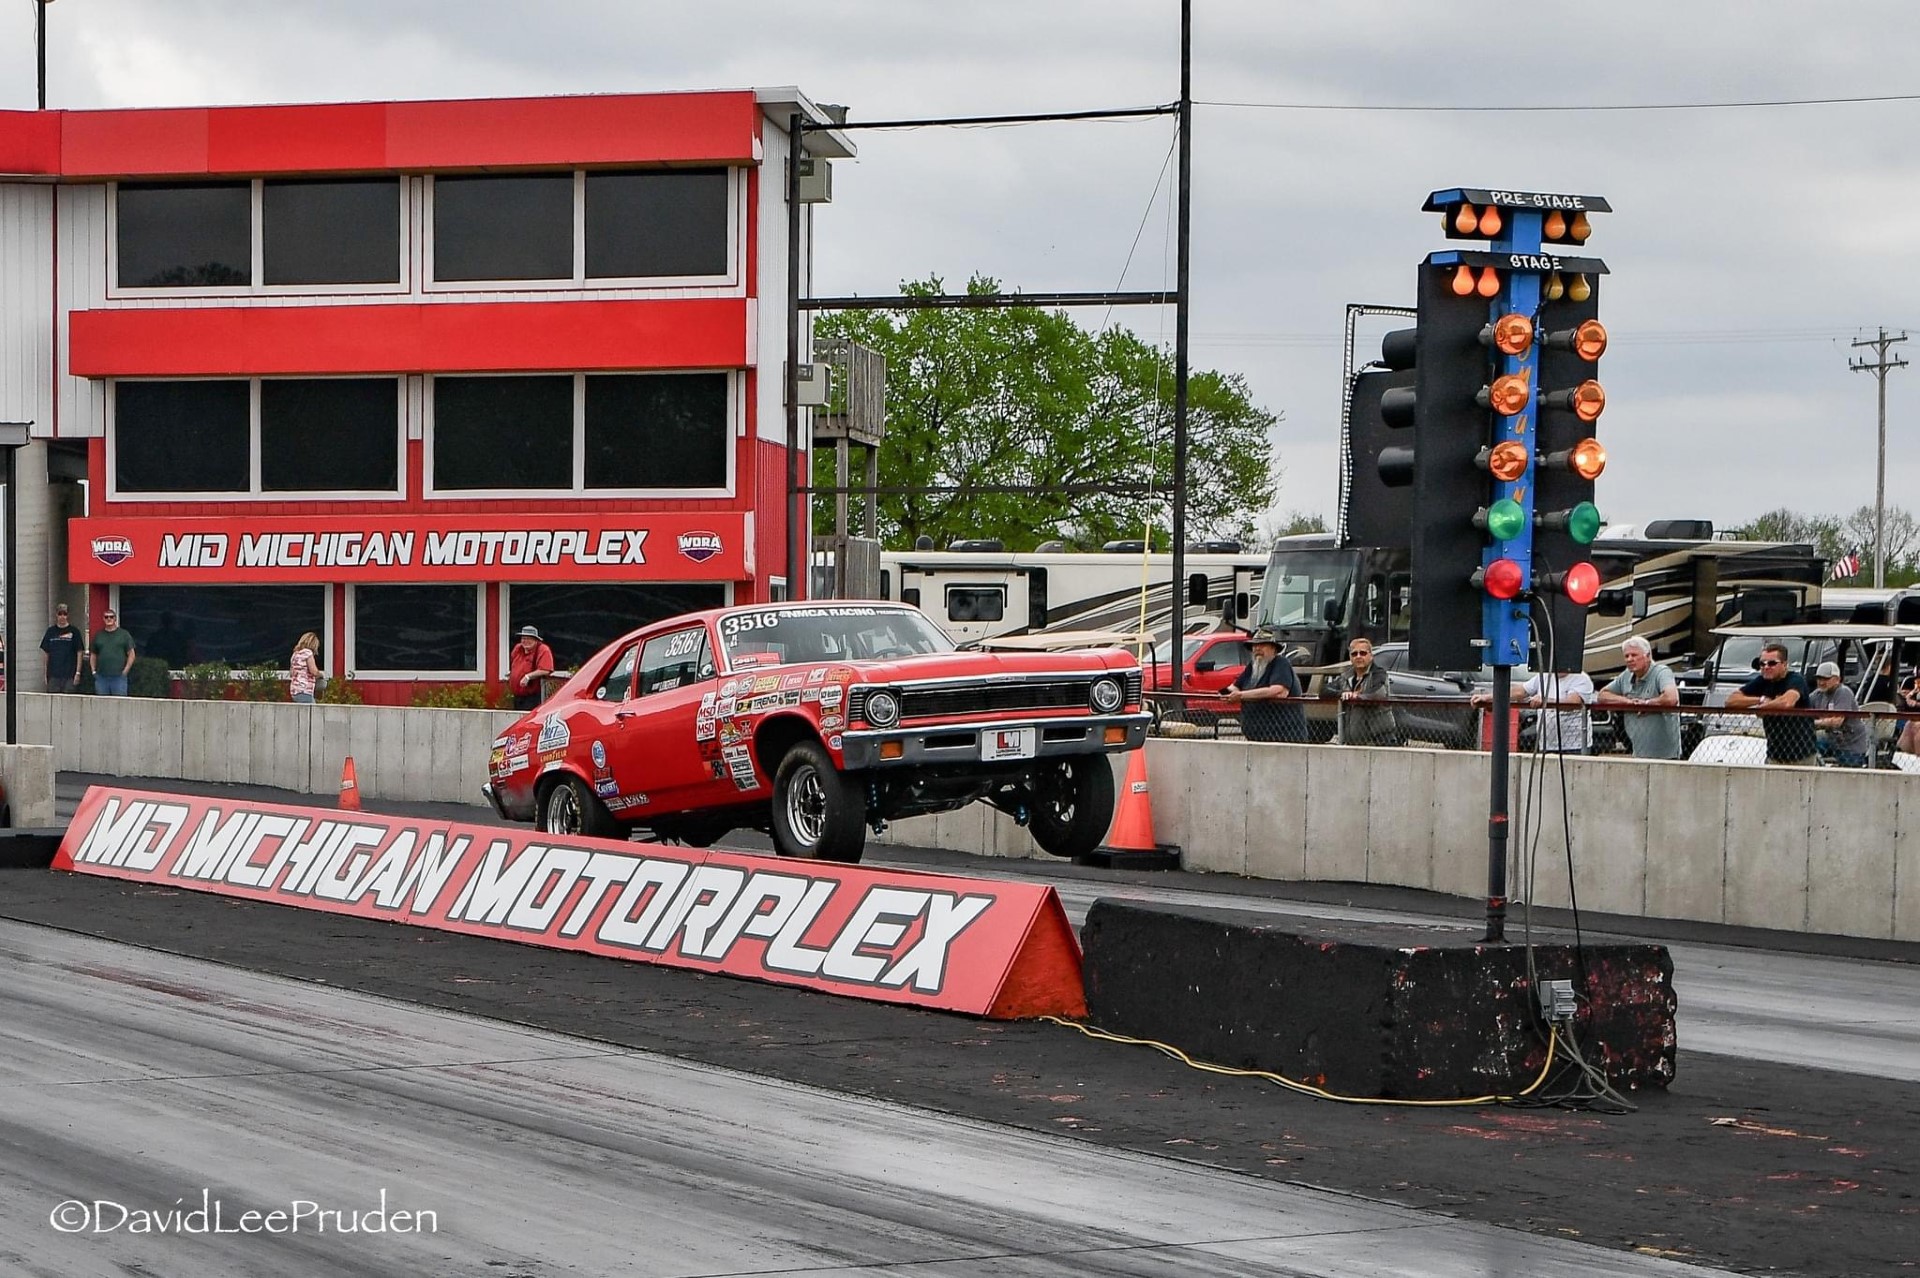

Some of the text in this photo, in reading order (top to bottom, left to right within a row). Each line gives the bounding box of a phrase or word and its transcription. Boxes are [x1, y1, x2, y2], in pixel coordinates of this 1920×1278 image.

[1490, 191, 1584, 209] PRE-STAGE
[1510, 255, 1563, 270] STAGE
[91, 540, 132, 553] WDRA
[159, 529, 649, 567] MID MICHIGAN MOTORPLEX
[678, 536, 721, 549] WDRA
[787, 609, 829, 618] NMCA
[829, 608, 876, 617] RACING
[725, 612, 779, 636] 3516
[664, 631, 698, 657] 3516
[698, 706, 716, 718] MSD
[697, 722, 715, 735] MSD
[997, 730, 1021, 749] LM
[74, 797, 189, 872] MID
[169, 807, 470, 915] MICHIGAN
[447, 837, 995, 992] MOTORPLEX
